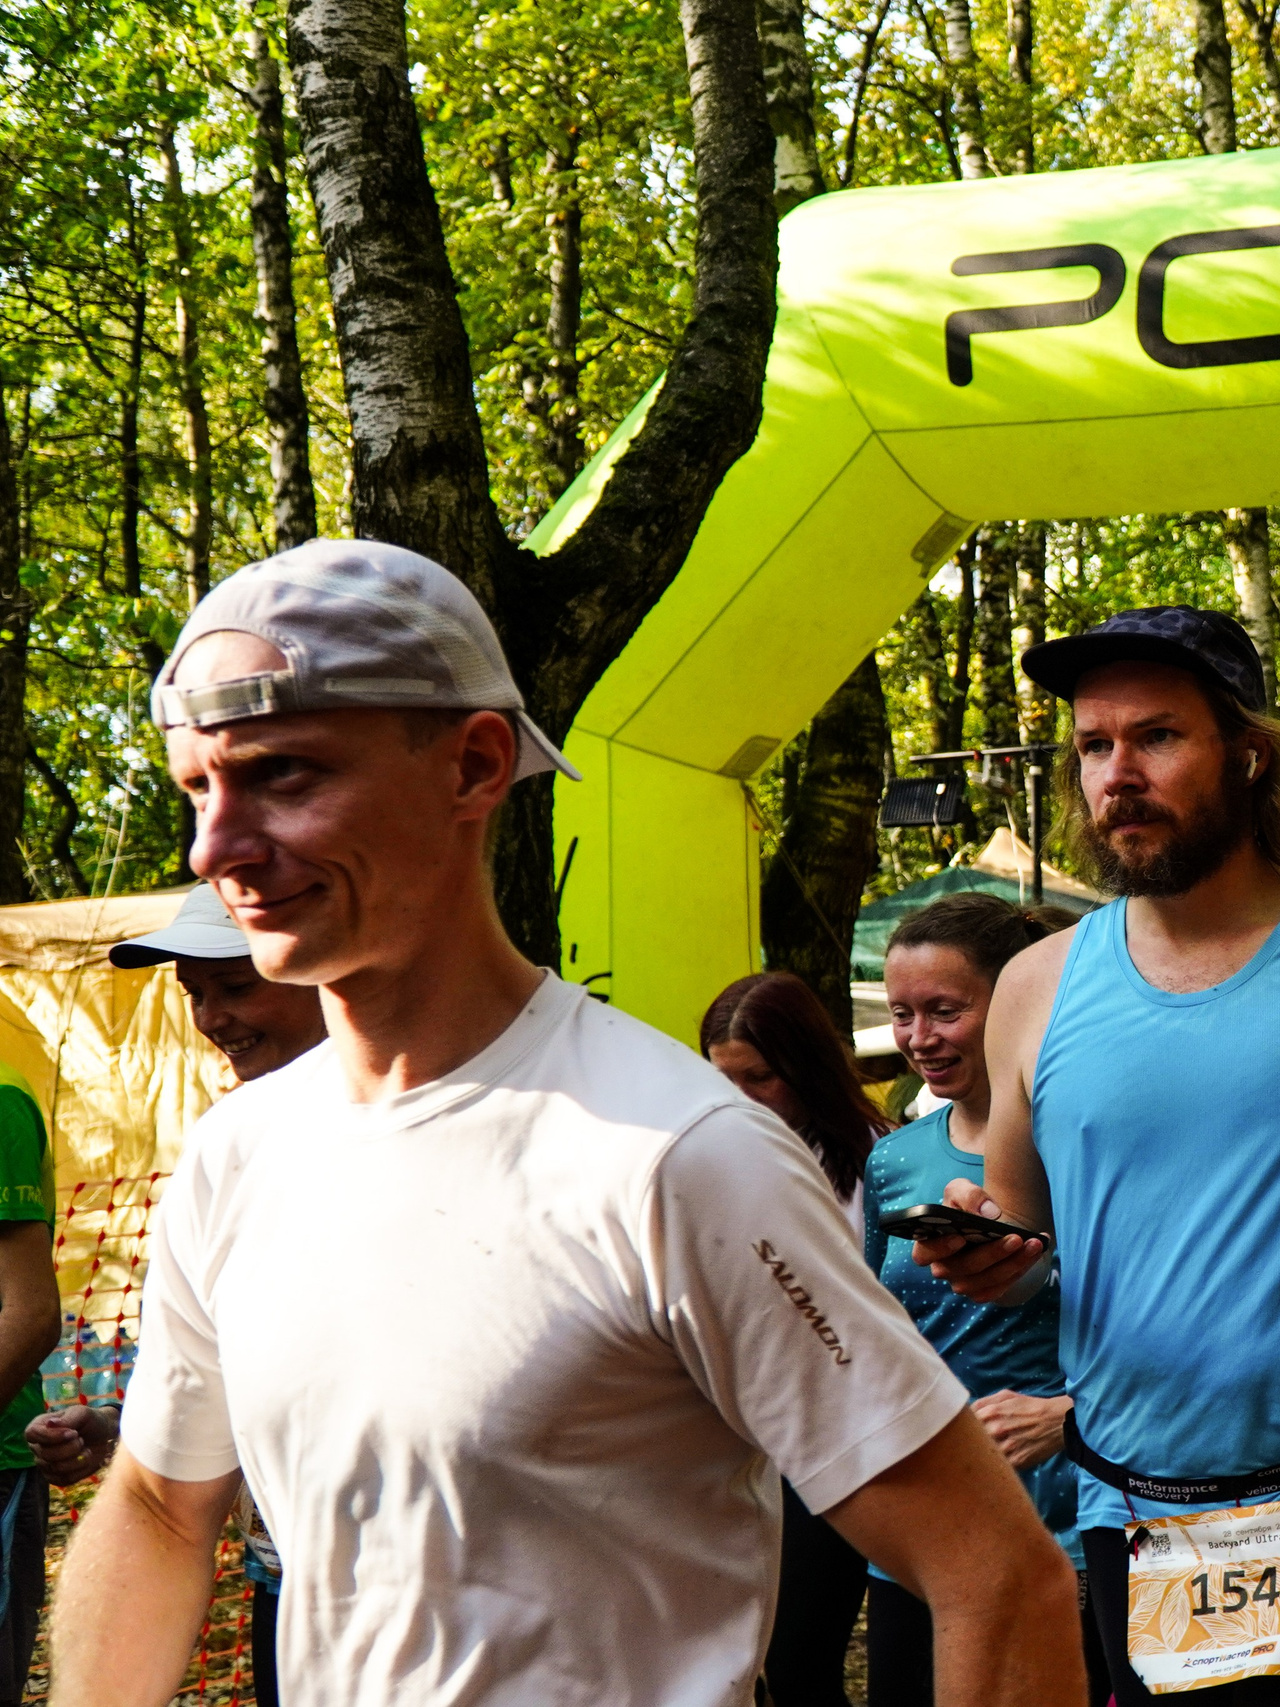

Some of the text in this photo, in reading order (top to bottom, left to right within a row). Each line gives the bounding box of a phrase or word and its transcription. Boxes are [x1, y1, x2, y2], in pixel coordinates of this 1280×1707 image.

[751, 1239, 852, 1366] SALOMON
[1128, 1477, 1219, 1494] performance
[1139, 1488, 1191, 1502] recovery
[1222, 1530, 1234, 1538] 28
[1236, 1525, 1272, 1537] сентября
[1208, 1537, 1251, 1550] Backyard
[1190, 1566, 1280, 1617] 154
[1250, 1643, 1276, 1657] PRO
